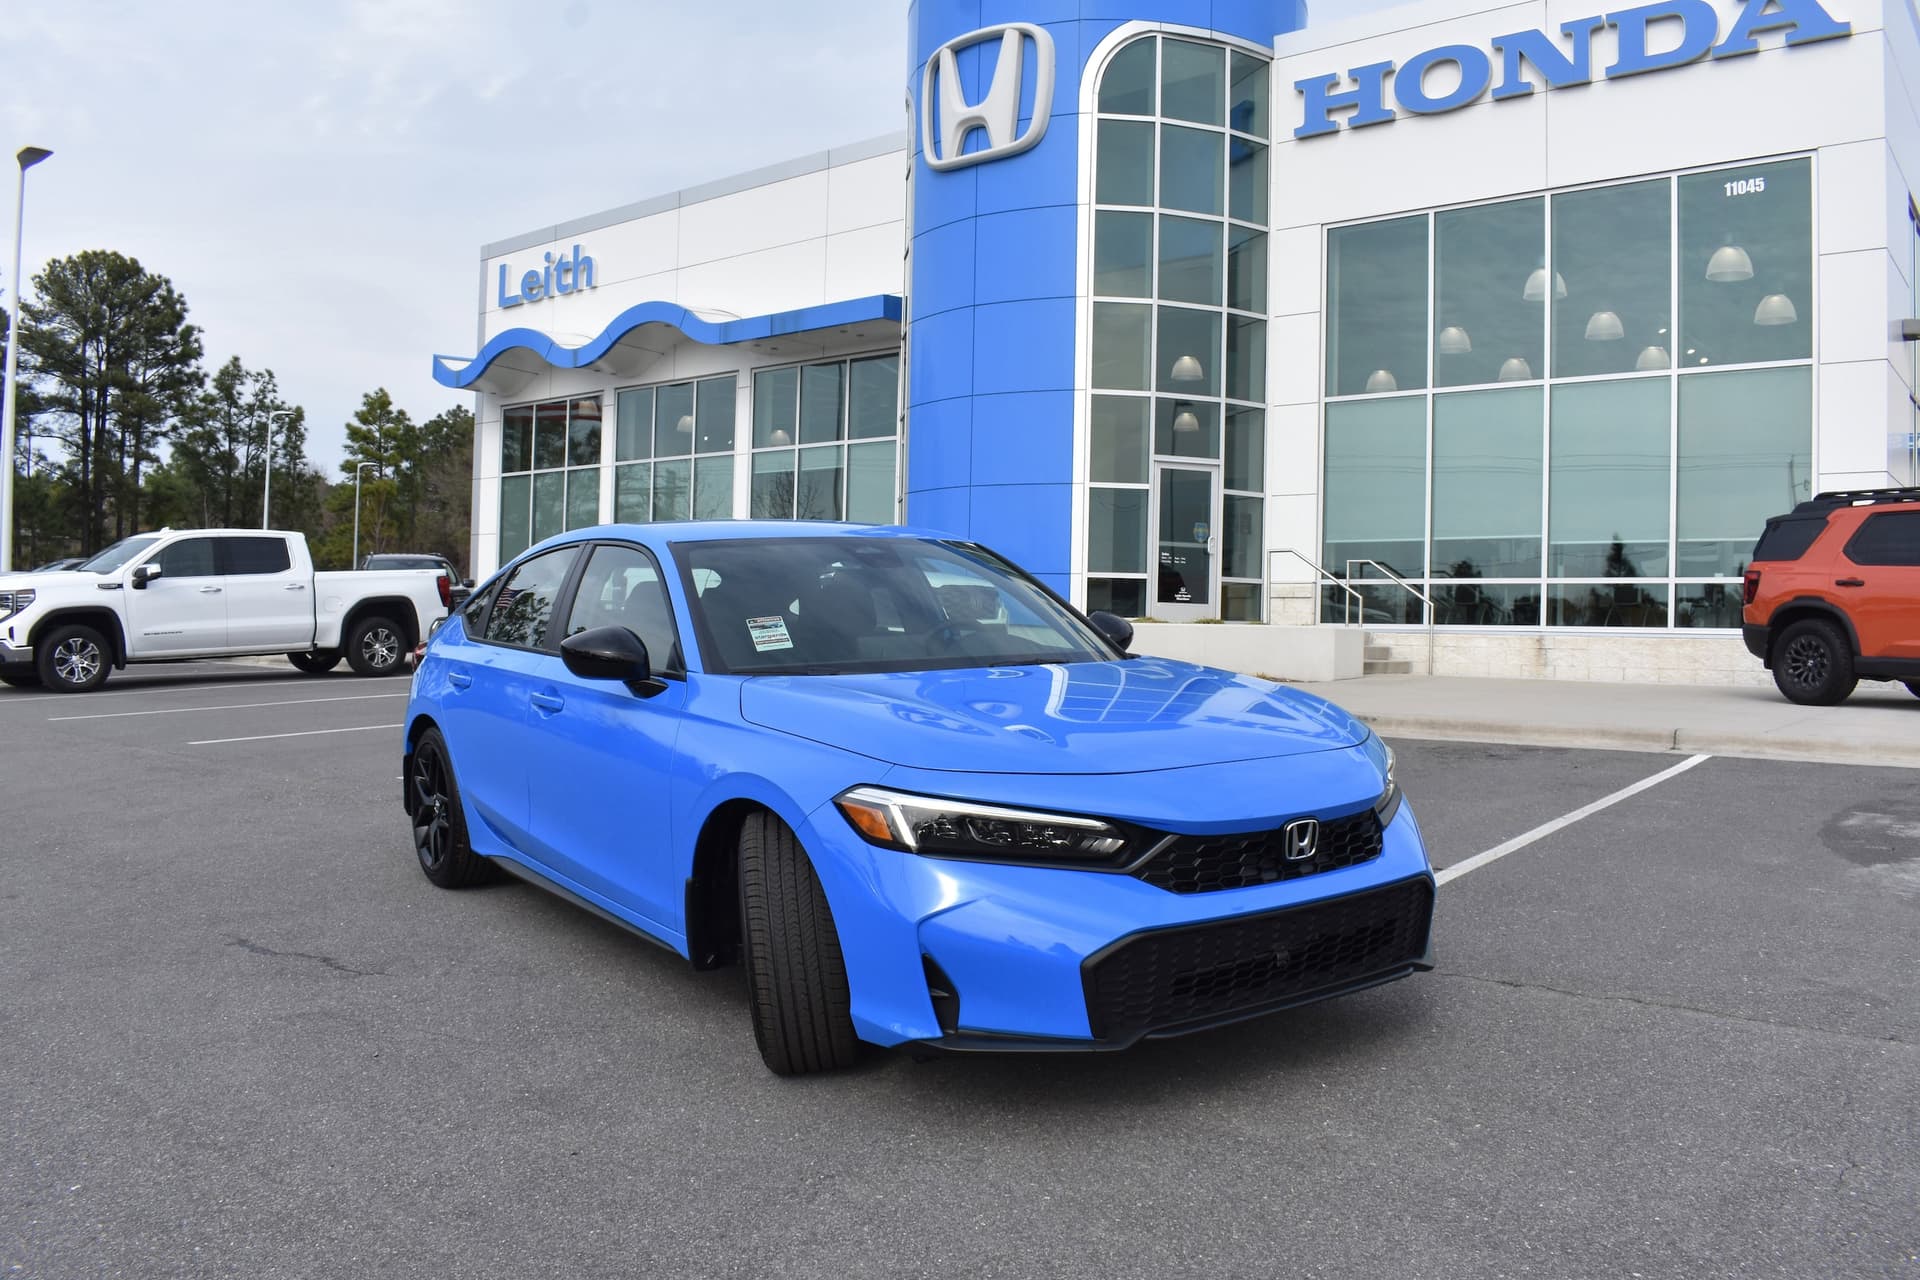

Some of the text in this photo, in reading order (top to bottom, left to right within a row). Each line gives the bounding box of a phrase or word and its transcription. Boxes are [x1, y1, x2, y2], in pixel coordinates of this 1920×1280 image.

[1295, 0, 1852, 138] HONDA
[1724, 177, 1765, 197] 11045
[498, 244, 597, 308] Leith
